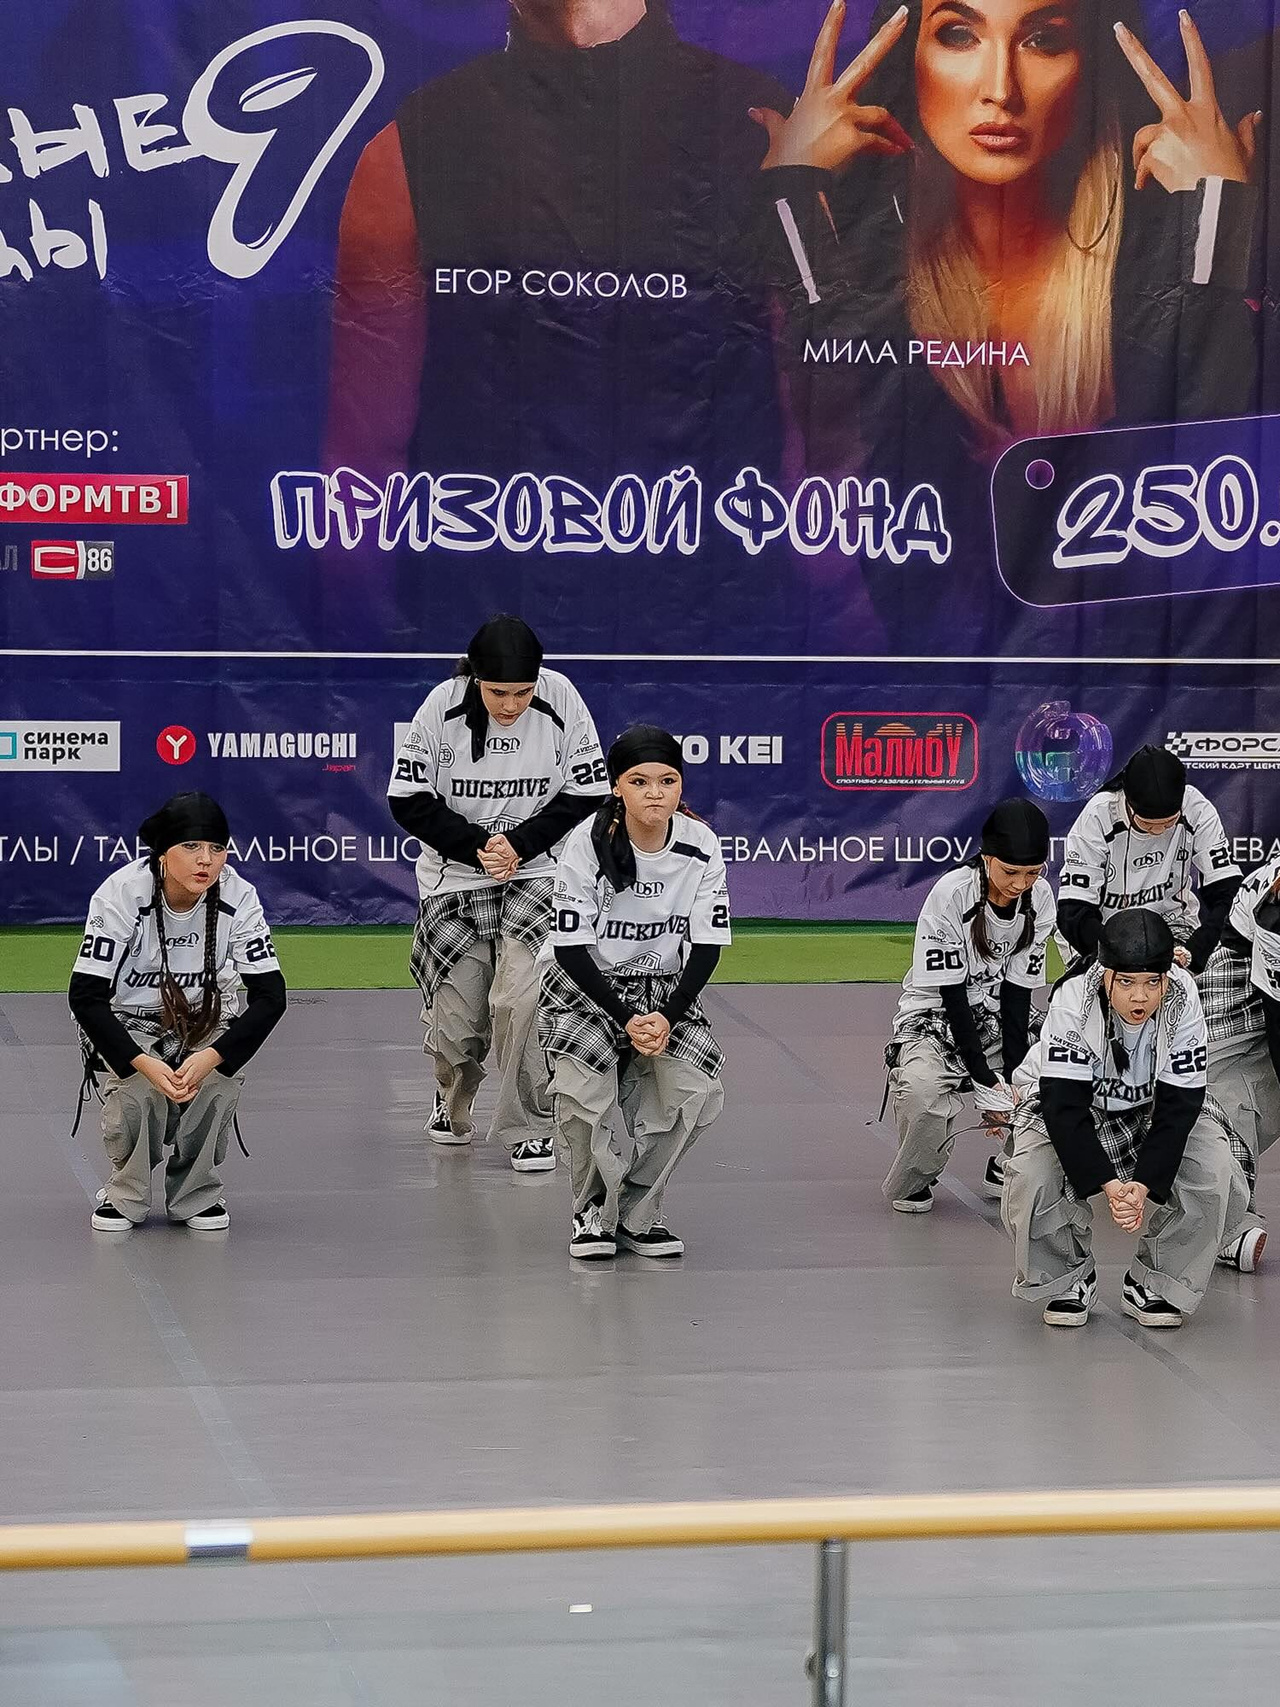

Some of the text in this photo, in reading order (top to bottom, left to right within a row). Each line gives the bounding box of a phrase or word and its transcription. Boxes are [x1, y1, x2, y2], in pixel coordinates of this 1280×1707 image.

[435, 268, 688, 298] ЕГОР СОКОЛОВ
[803, 338, 1030, 369] МИЛА РЕДИНА
[0, 428, 119, 458] ртнер:
[271, 465, 952, 564] ПРИЗОВОЙ ФОНД
[23, 731, 109, 746] синема
[207, 732, 357, 759] YAMAGUCHI
[719, 735, 783, 765] KEI
[23, 746, 82, 765] парк
[1182, 761, 1219, 770] ТСКИЙ
[1221, 762, 1252, 770] КАРТ
[571, 758, 607, 785] 22
[451, 777, 551, 799] DUCKDIVE
[368, 836, 424, 862] ШО
[895, 836, 972, 863] ШОУ
[712, 904, 728, 929] 2
[80, 935, 115, 962] 20
[926, 949, 964, 971] 20
